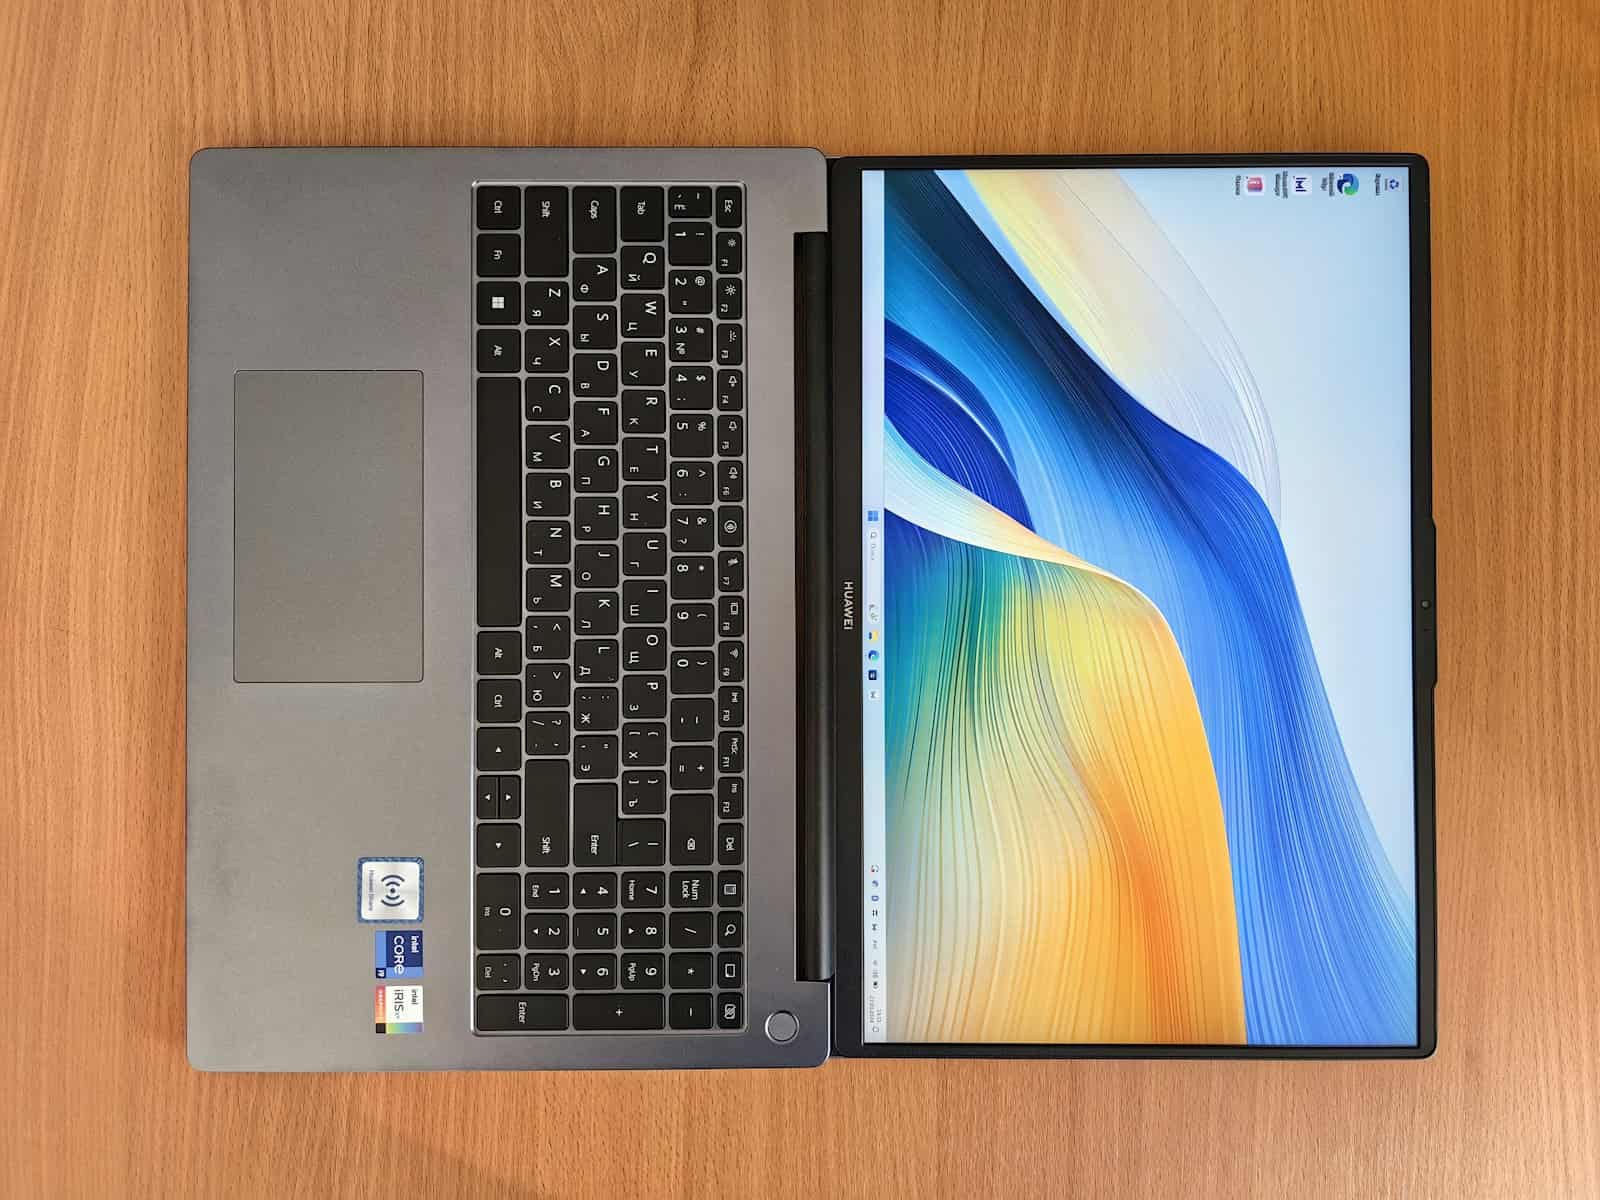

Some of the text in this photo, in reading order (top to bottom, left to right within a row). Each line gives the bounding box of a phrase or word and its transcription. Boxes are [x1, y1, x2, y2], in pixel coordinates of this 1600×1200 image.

[494, 200, 503, 213] Ctrl
[542, 201, 550, 218] Shift
[589, 200, 599, 219] Caps
[637, 201, 646, 215] Tab
[724, 200, 733, 213] Esc
[494, 250, 502, 260] Fn
[642, 252, 656, 264] Q
[721, 259, 728, 267] F1
[597, 265, 608, 275] A
[675, 277, 687, 286] 2
[549, 288, 561, 297] Z
[580, 284, 589, 293] Ф
[645, 301, 657, 315] W
[721, 304, 728, 312] F2
[597, 313, 609, 321] S
[627, 322, 638, 331] Ц
[675, 326, 687, 334] 3
[549, 337, 561, 346] X
[580, 334, 589, 342] Ы
[494, 345, 502, 356] Alt
[645, 349, 657, 357] E
[721, 350, 728, 358] F3
[532, 357, 541, 365] Ч
[597, 361, 609, 371] D
[676, 374, 687, 382] 4
[549, 385, 561, 394] C
[646, 397, 658, 405] R
[722, 395, 729, 404] F4
[677, 422, 688, 430] 5
[549, 433, 561, 442] V
[646, 445, 658, 454] T
[598, 456, 610, 466] G
[677, 469, 688, 477] 6
[550, 480, 562, 488] B
[581, 477, 591, 485] П
[723, 487, 730, 495] F6
[646, 493, 658, 502] Y
[533, 501, 542, 509] И
[598, 505, 610, 515] H
[677, 517, 689, 525] 7
[550, 528, 562, 537] N
[647, 540, 659, 549] U
[677, 564, 689, 572] 8
[550, 575, 562, 587] M
[723, 577, 730, 585] F7
[598, 599, 610, 608] K
[844, 582, 853, 630] HUAWEI
[630, 604, 640, 616] Ш
[677, 612, 689, 620] 9
[581, 620, 591, 628] Л
[723, 622, 730, 630] F8
[646, 634, 658, 646] O
[495, 648, 503, 659] Alt
[628, 651, 639, 664] Щ
[677, 659, 689, 667] 0
[579, 666, 591, 676] Д
[723, 667, 730, 676] F9
[647, 682, 658, 690] P
[533, 690, 542, 701] Ю
[494, 694, 502, 708] Ctrl
[581, 713, 590, 723] Ж
[722, 757, 730, 767] F11
[629, 799, 638, 807] Ъ
[542, 837, 551, 854] Shift
[591, 835, 599, 855] Enter
[726, 837, 735, 851] Del
[597, 886, 608, 895] 4
[646, 886, 657, 894] 7
[682, 880, 690, 898] Lock
[691, 880, 700, 900] Num
[500, 908, 511, 916] 0
[645, 927, 657, 935] 8
[410, 935, 419, 953] intel
[531, 963, 540, 981] PgDn
[548, 968, 560, 976] 3
[597, 968, 609, 976] 6
[628, 962, 636, 981] PgUp
[645, 968, 657, 976] 9
[411, 989, 419, 1005] intel
[518, 1002, 527, 1024] Enter
